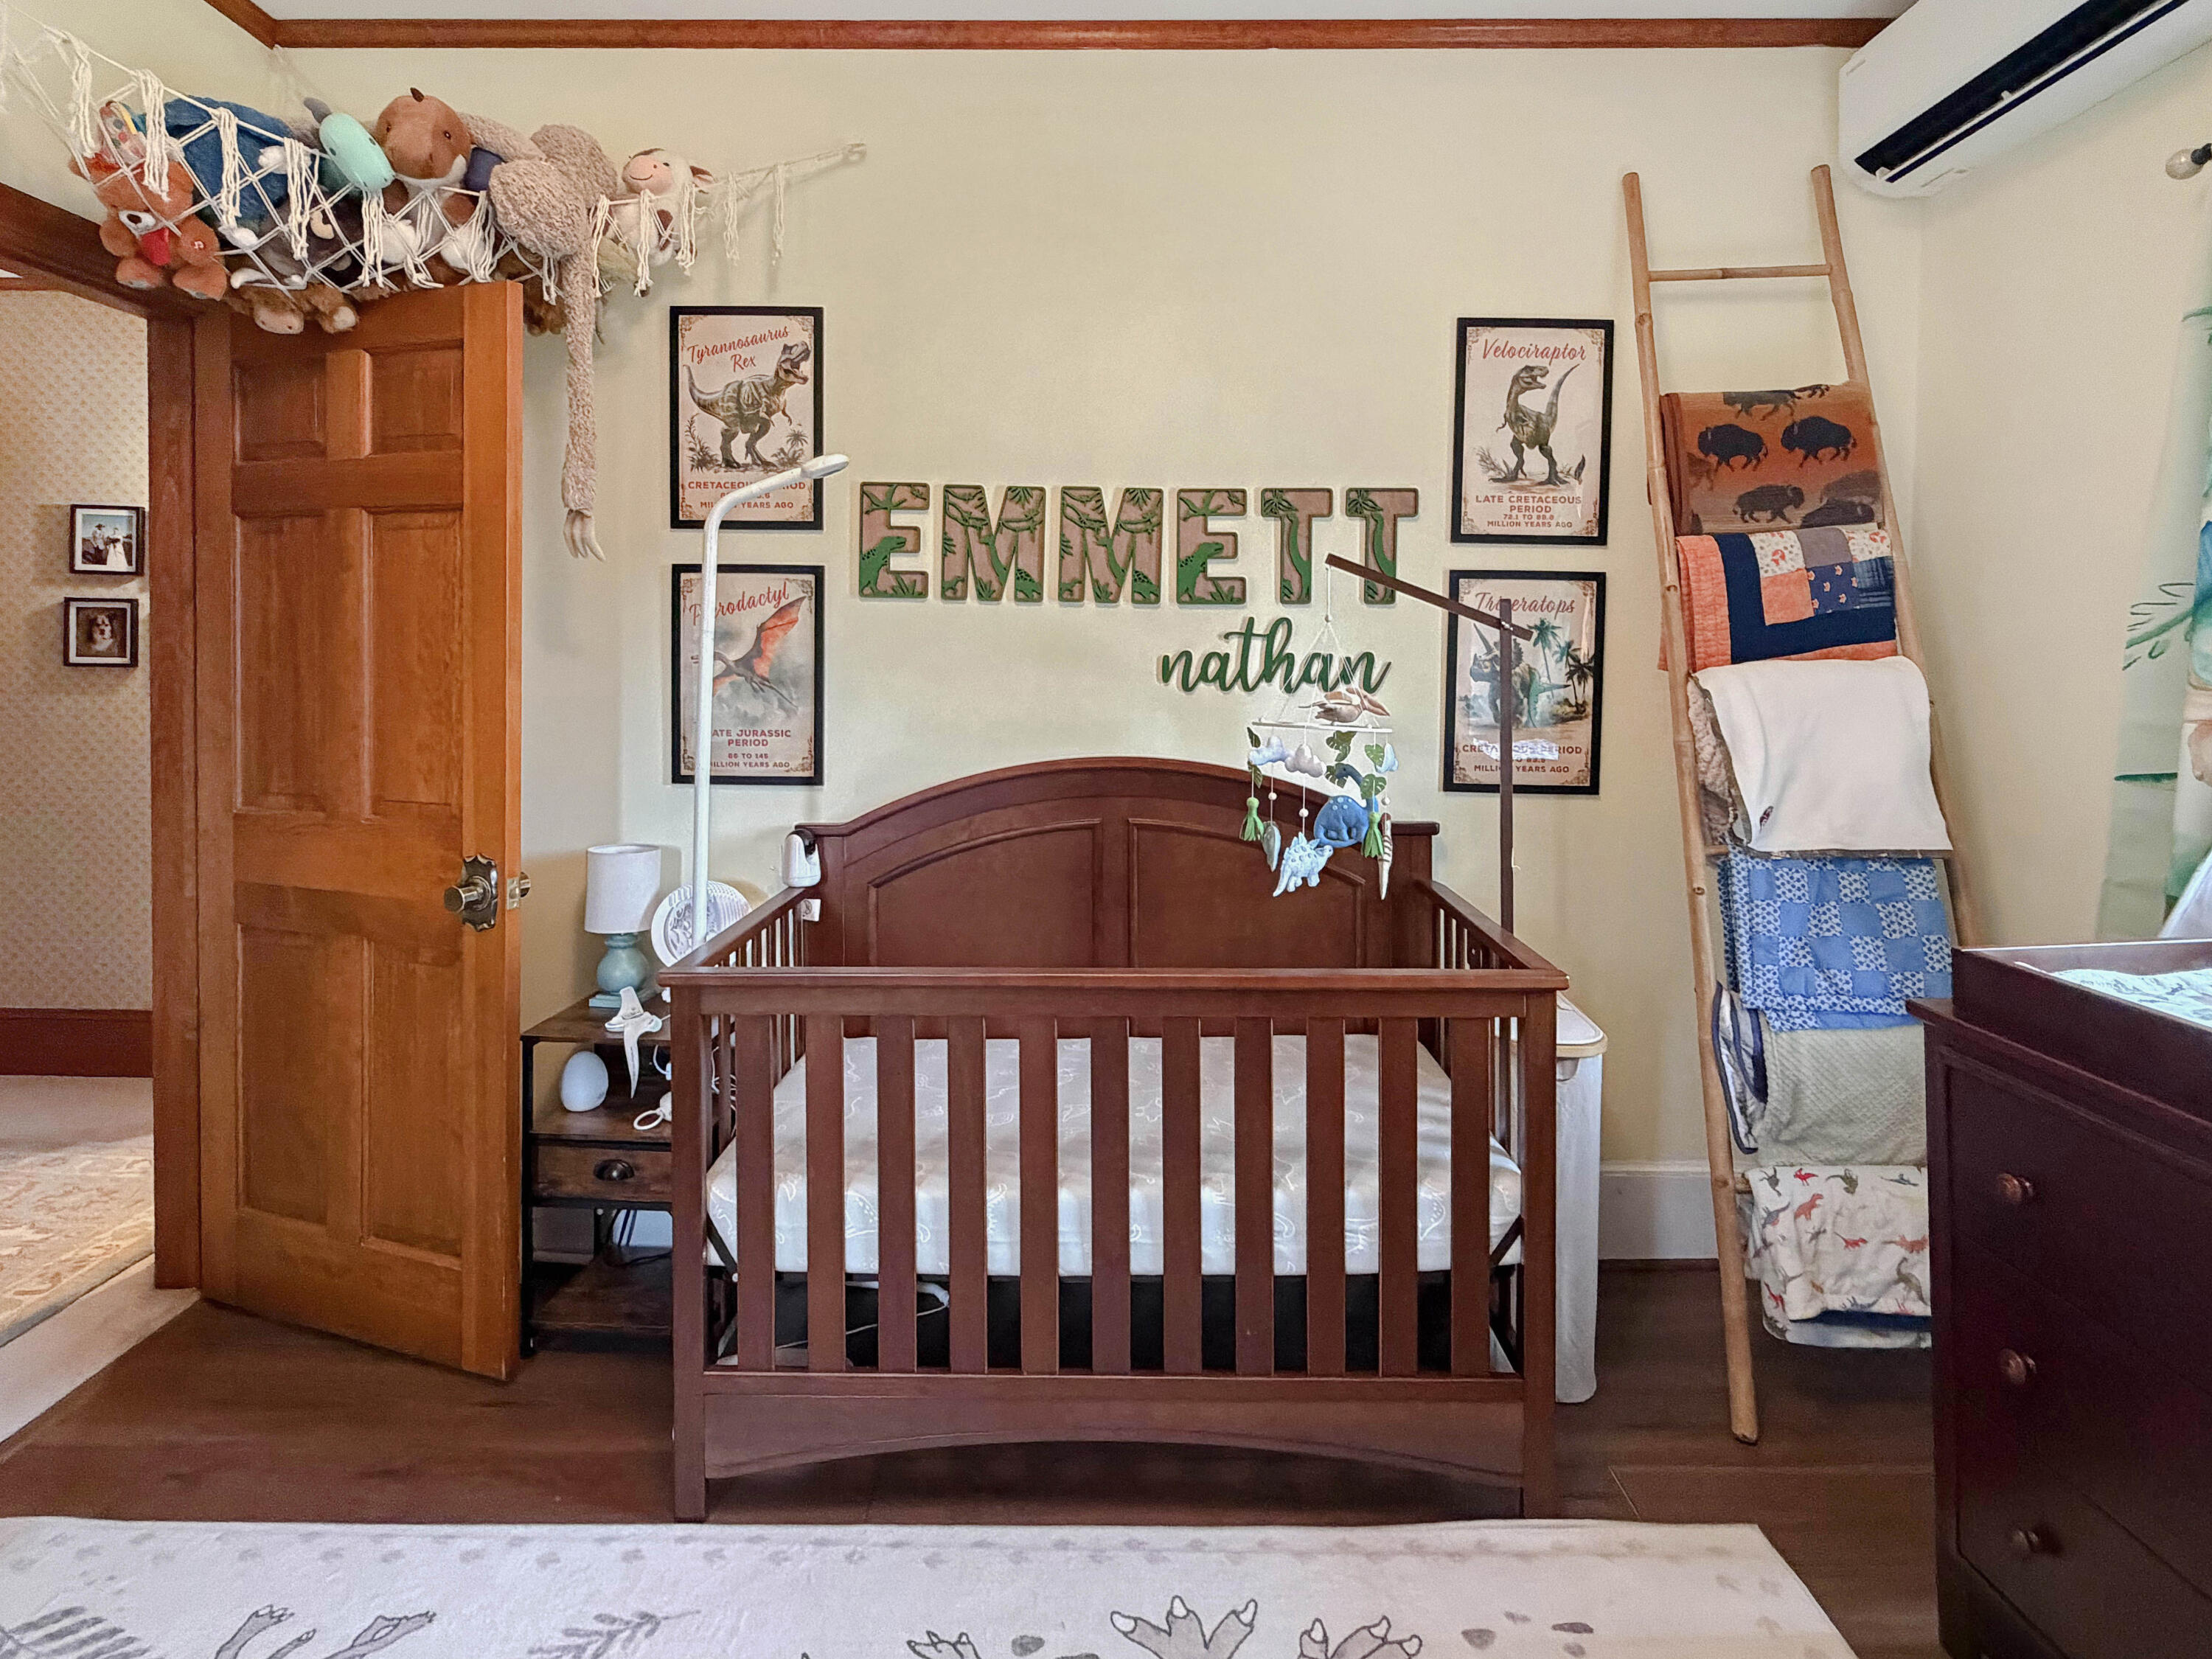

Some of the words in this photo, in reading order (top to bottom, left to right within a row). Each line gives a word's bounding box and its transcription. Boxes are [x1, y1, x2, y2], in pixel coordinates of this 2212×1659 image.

[687, 326, 790, 365] Tyrannosaurus
[1482, 338, 1587, 366] Velociraptor
[730, 353, 757, 372] Rex
[688, 481, 754, 490] CRETACEO
[1475, 495, 1504, 504] LATE
[1508, 495, 1582, 504] CRETACEOUS
[1509, 505, 1552, 513] PERIOD
[858, 481, 1419, 605] EMMETT
[689, 581, 790, 626] Prodactyl
[1475, 592, 1576, 620] Trieratops
[1161, 616, 1392, 694] nathan
[712, 729, 732, 737] ATE
[737, 729, 791, 737] JURASSIC
[728, 739, 769, 747] PERIOD
